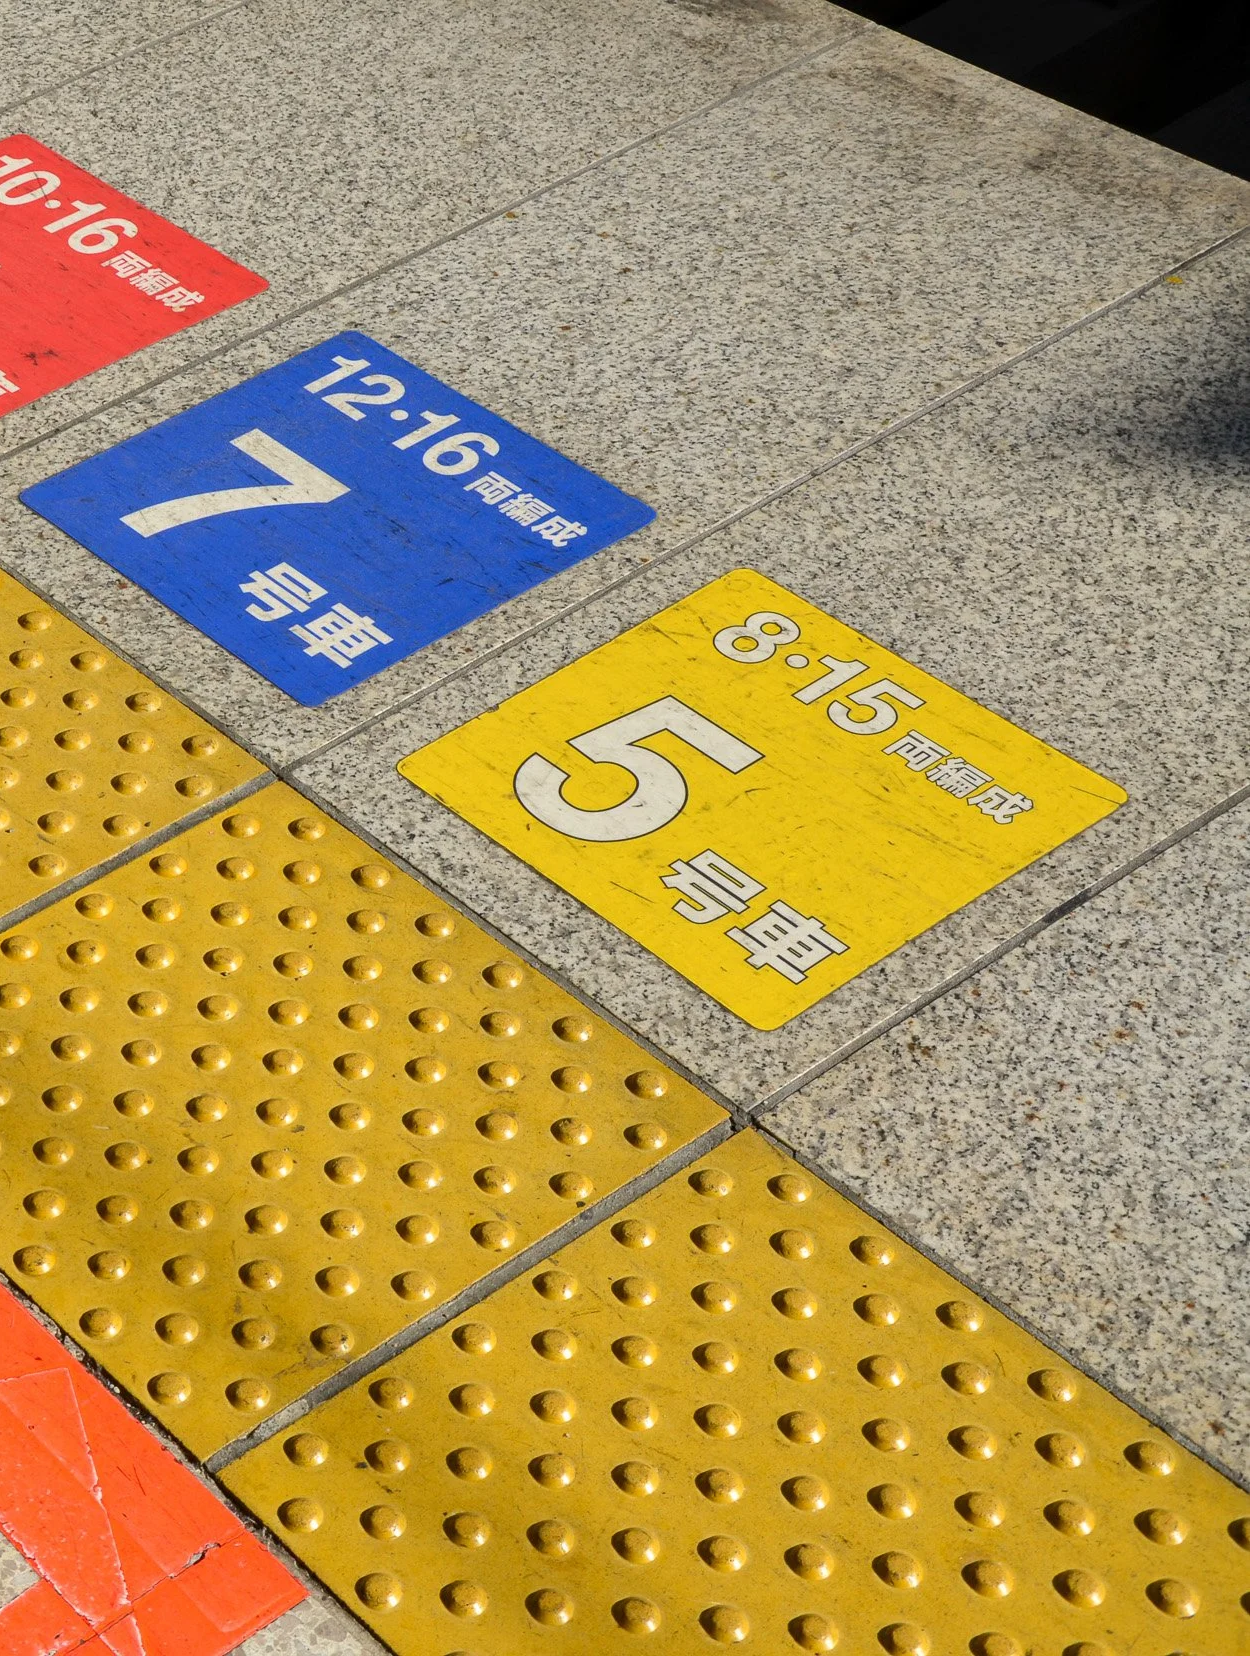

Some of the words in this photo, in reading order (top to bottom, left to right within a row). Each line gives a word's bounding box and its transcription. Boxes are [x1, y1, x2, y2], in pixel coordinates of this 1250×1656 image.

[101, 250, 205, 312] 両編成
[119, 427, 351, 539] 7
[238, 561, 394, 669] 号車
[463, 470, 588, 548] 両編成
[882, 729, 1034, 825] 両編成
[514, 695, 764, 843] 5
[660, 848, 849, 985] 号車
